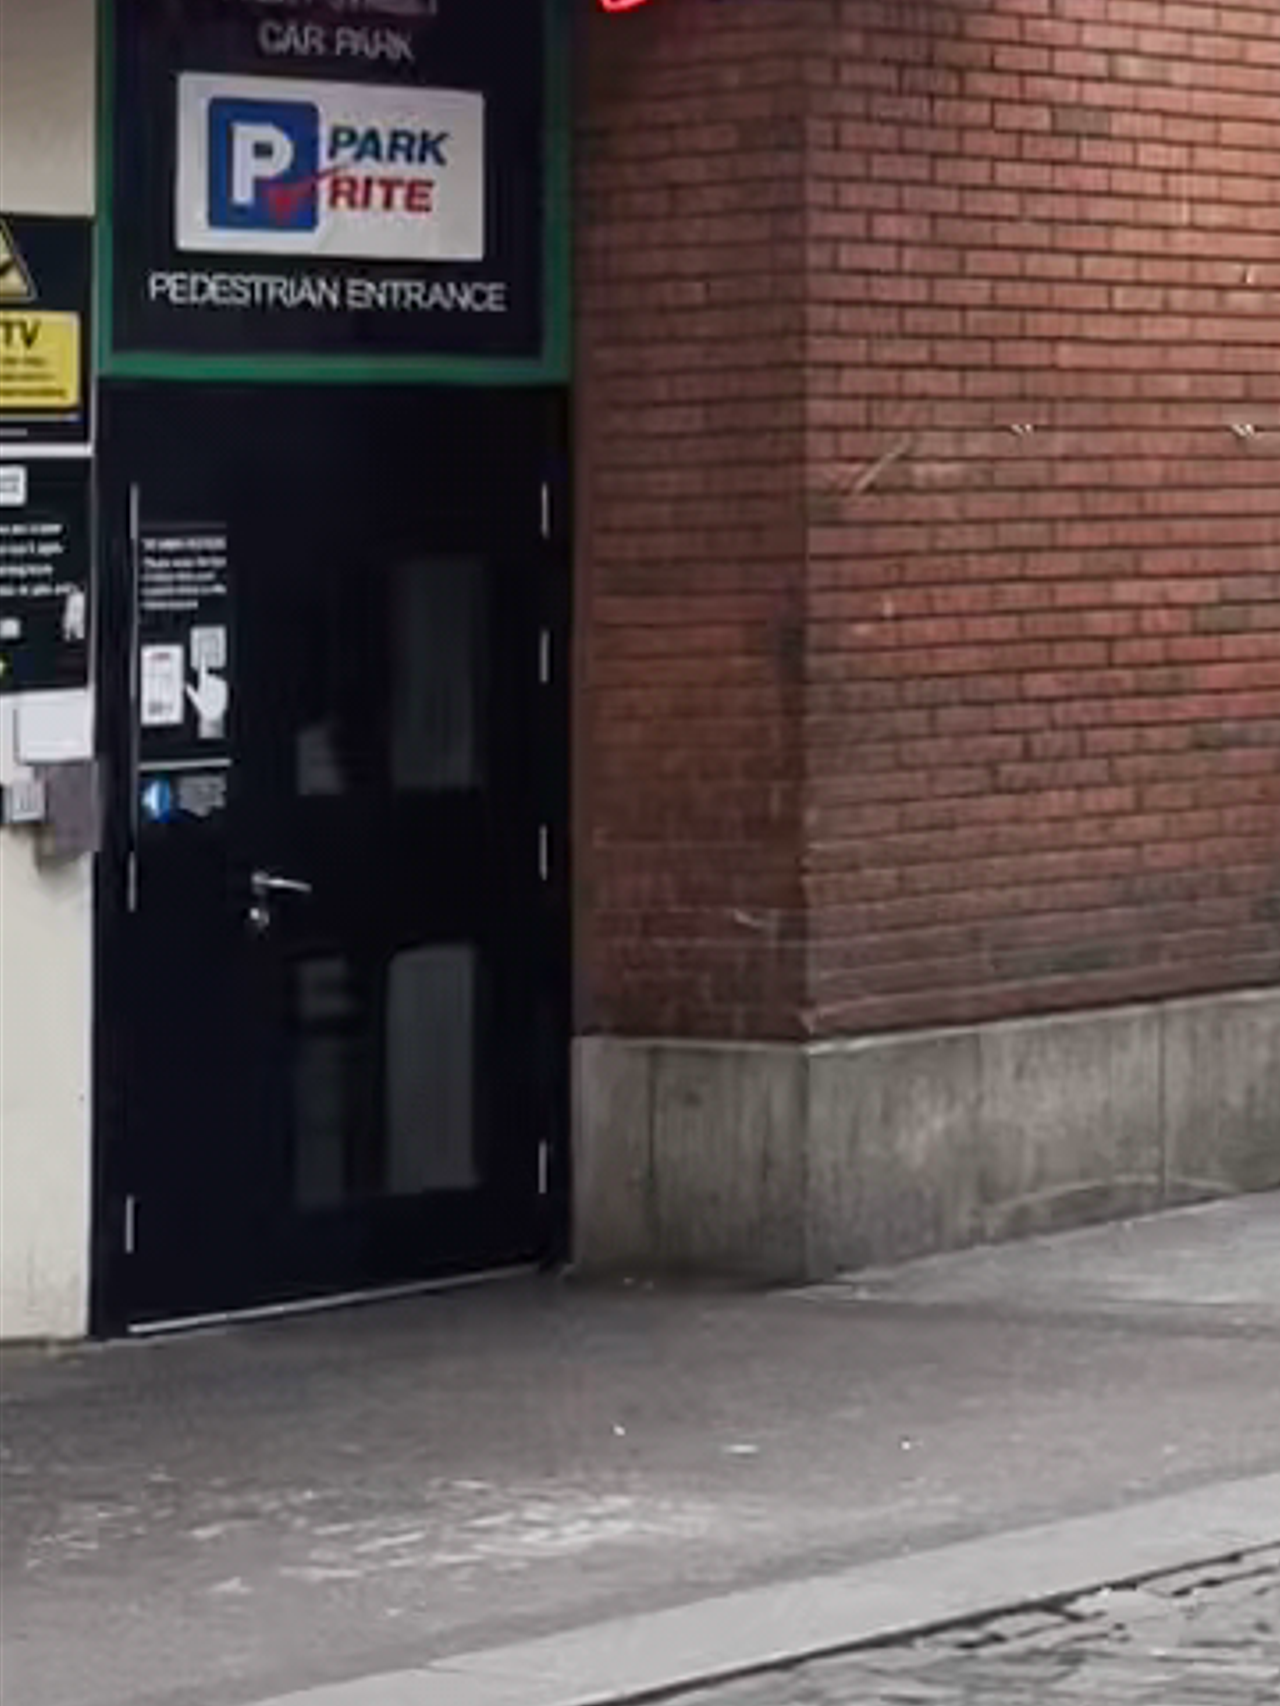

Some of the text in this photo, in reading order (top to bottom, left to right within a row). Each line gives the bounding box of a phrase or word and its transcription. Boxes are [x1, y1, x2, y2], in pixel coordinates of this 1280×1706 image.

[258, 20, 415, 62] CAR PARK
[327, 124, 450, 166] PARK
[327, 176, 435, 214] RITE
[149, 272, 507, 313] PEDESTRIAN ENTRANCE
